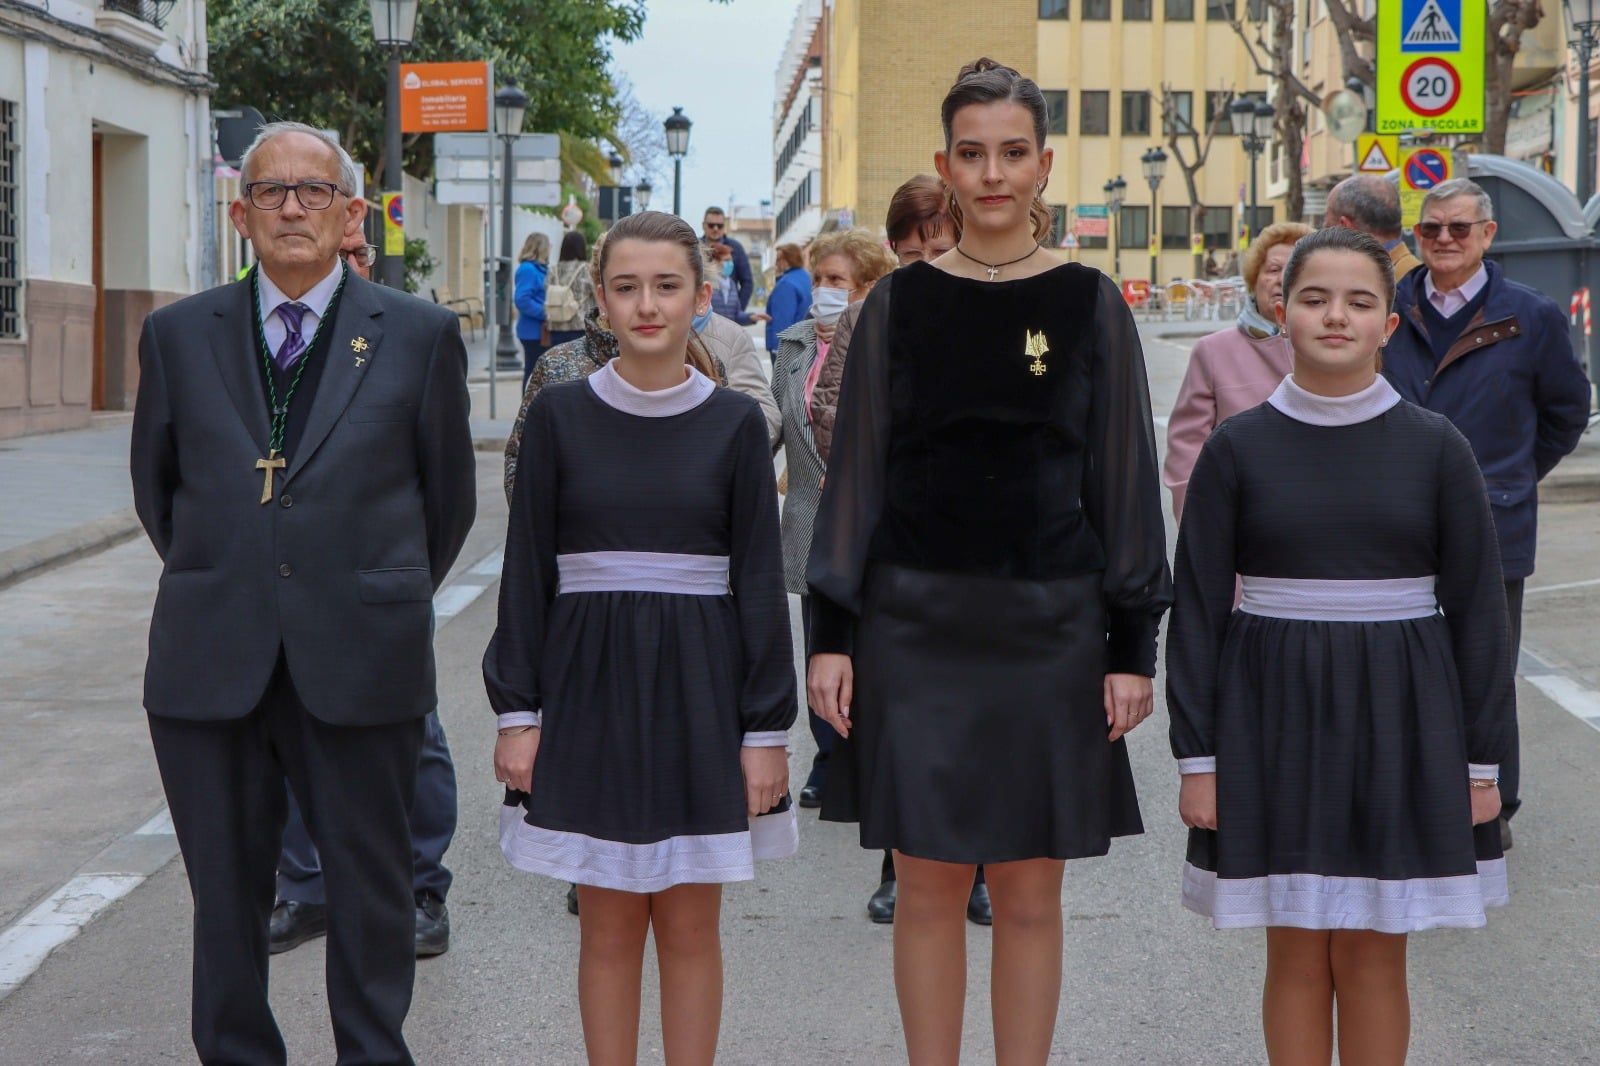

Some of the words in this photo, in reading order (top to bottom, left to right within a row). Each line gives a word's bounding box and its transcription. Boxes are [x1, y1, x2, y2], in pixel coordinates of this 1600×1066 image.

[450, 77, 484, 87] SERVICES
[1416, 76, 1447, 97] 20
[421, 95, 467, 104] Inmobiliaria
[1382, 119, 1415, 130] ZONA
[1422, 118, 1478, 130] ESCOLAR
